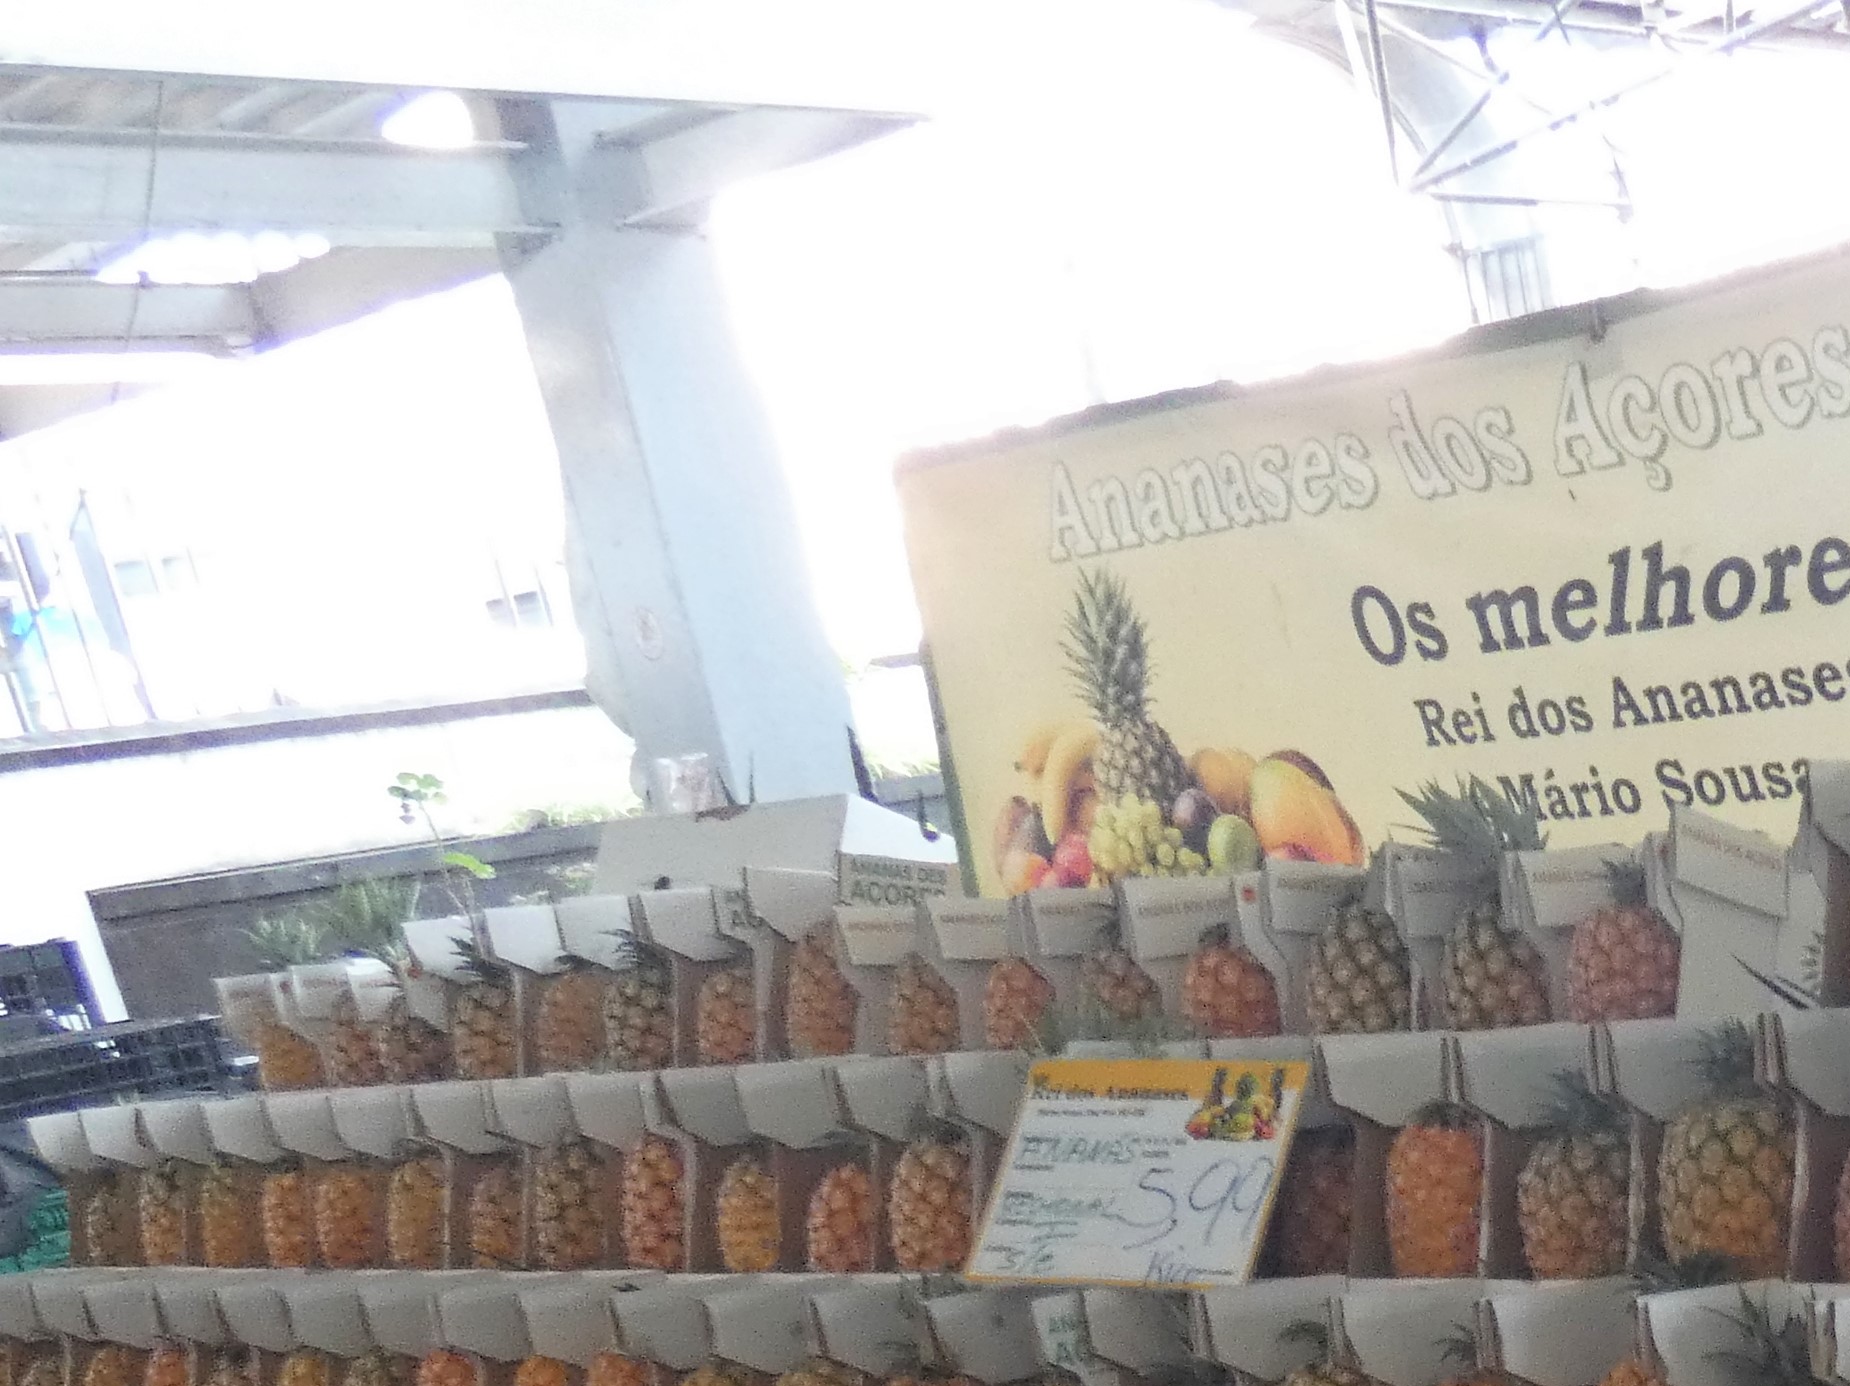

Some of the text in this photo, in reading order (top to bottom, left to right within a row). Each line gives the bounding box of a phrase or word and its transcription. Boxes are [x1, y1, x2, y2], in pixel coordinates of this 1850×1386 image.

[1049, 430, 1381, 563] Ananases
[1388, 388, 1534, 501] dos
[1350, 583, 1449, 667] Os
[1414, 692, 1498, 749] Rei
[1507, 676, 1595, 740] dos
[1497, 764, 1642, 823] Mário
